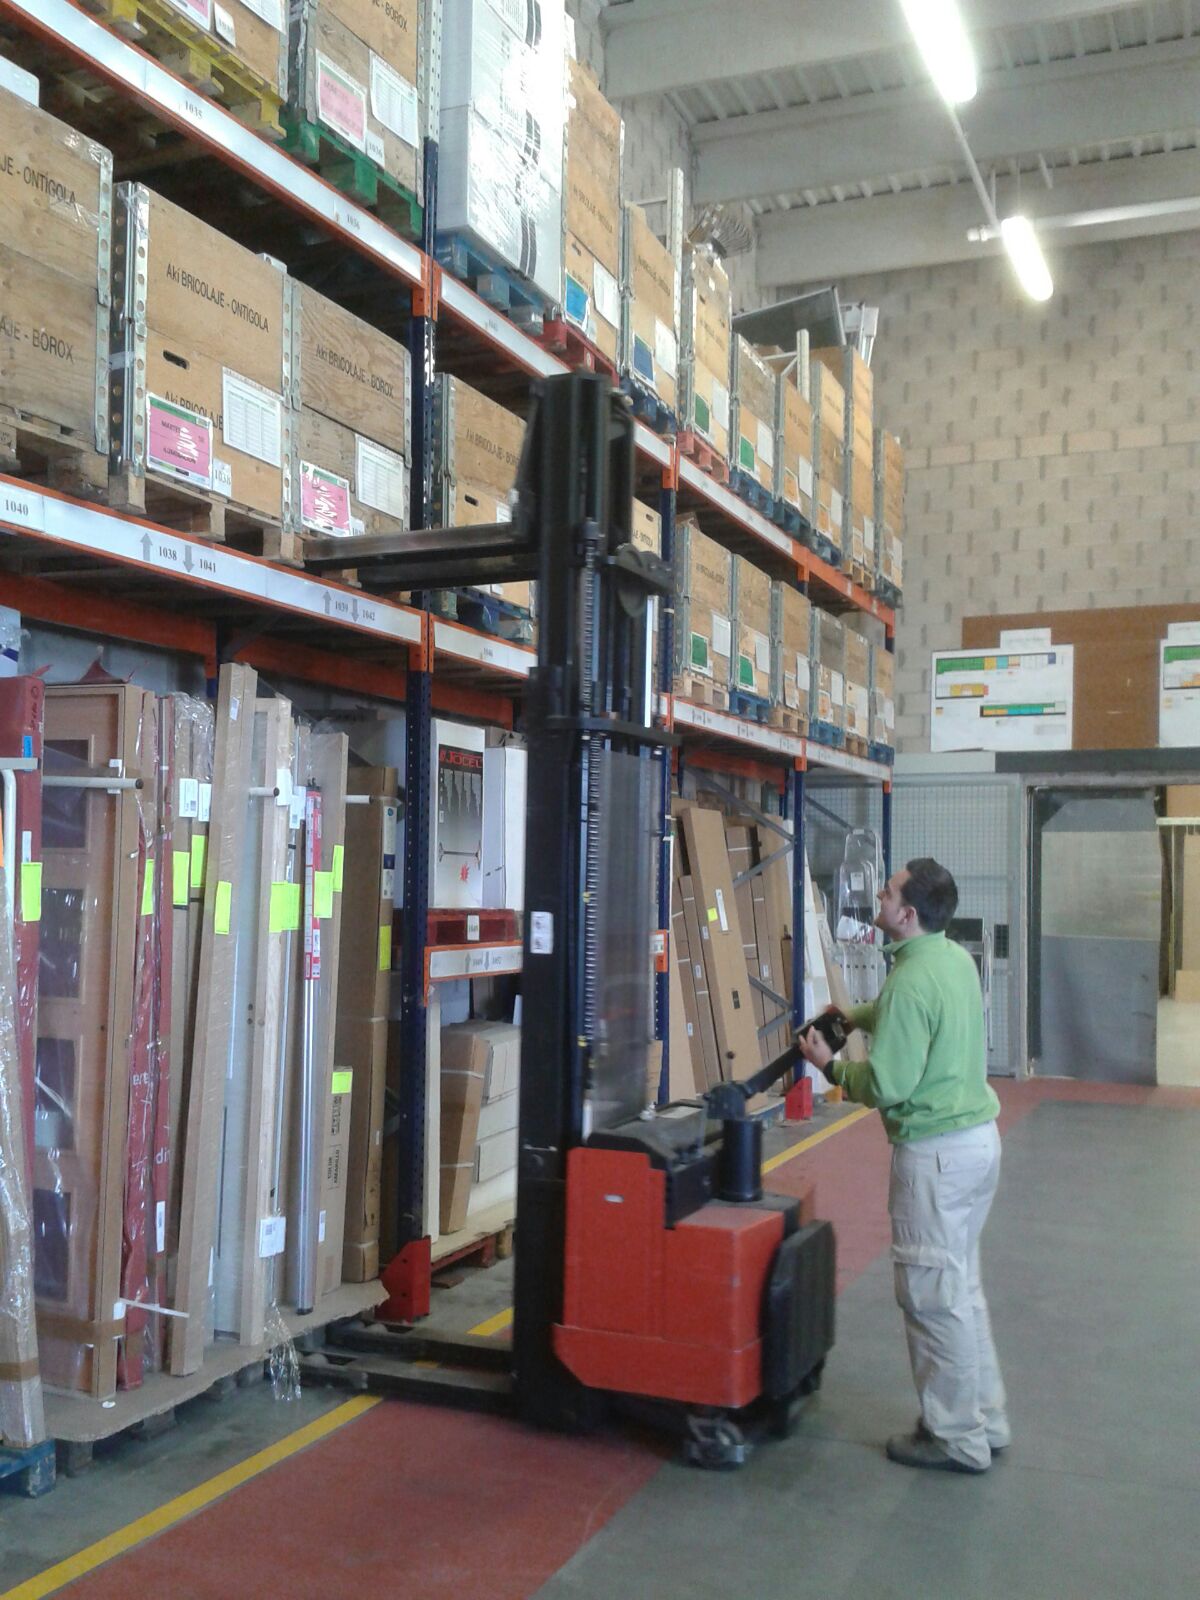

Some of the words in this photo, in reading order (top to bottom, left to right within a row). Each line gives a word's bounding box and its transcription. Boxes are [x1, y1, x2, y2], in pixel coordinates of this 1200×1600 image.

[384, 1, 408, 33] BOROX
[181, 270, 225, 309] BRICOLAJE
[32, 328, 75, 364] BOROX
[328, 350, 366, 384] BRICOLAJE
[370, 374, 395, 399] BOROX
[5, 499, 30, 516] 1040
[159, 545, 178, 561] 1038
[200, 558, 217, 573] 1041
[448, 750, 483, 769] JOCEL
